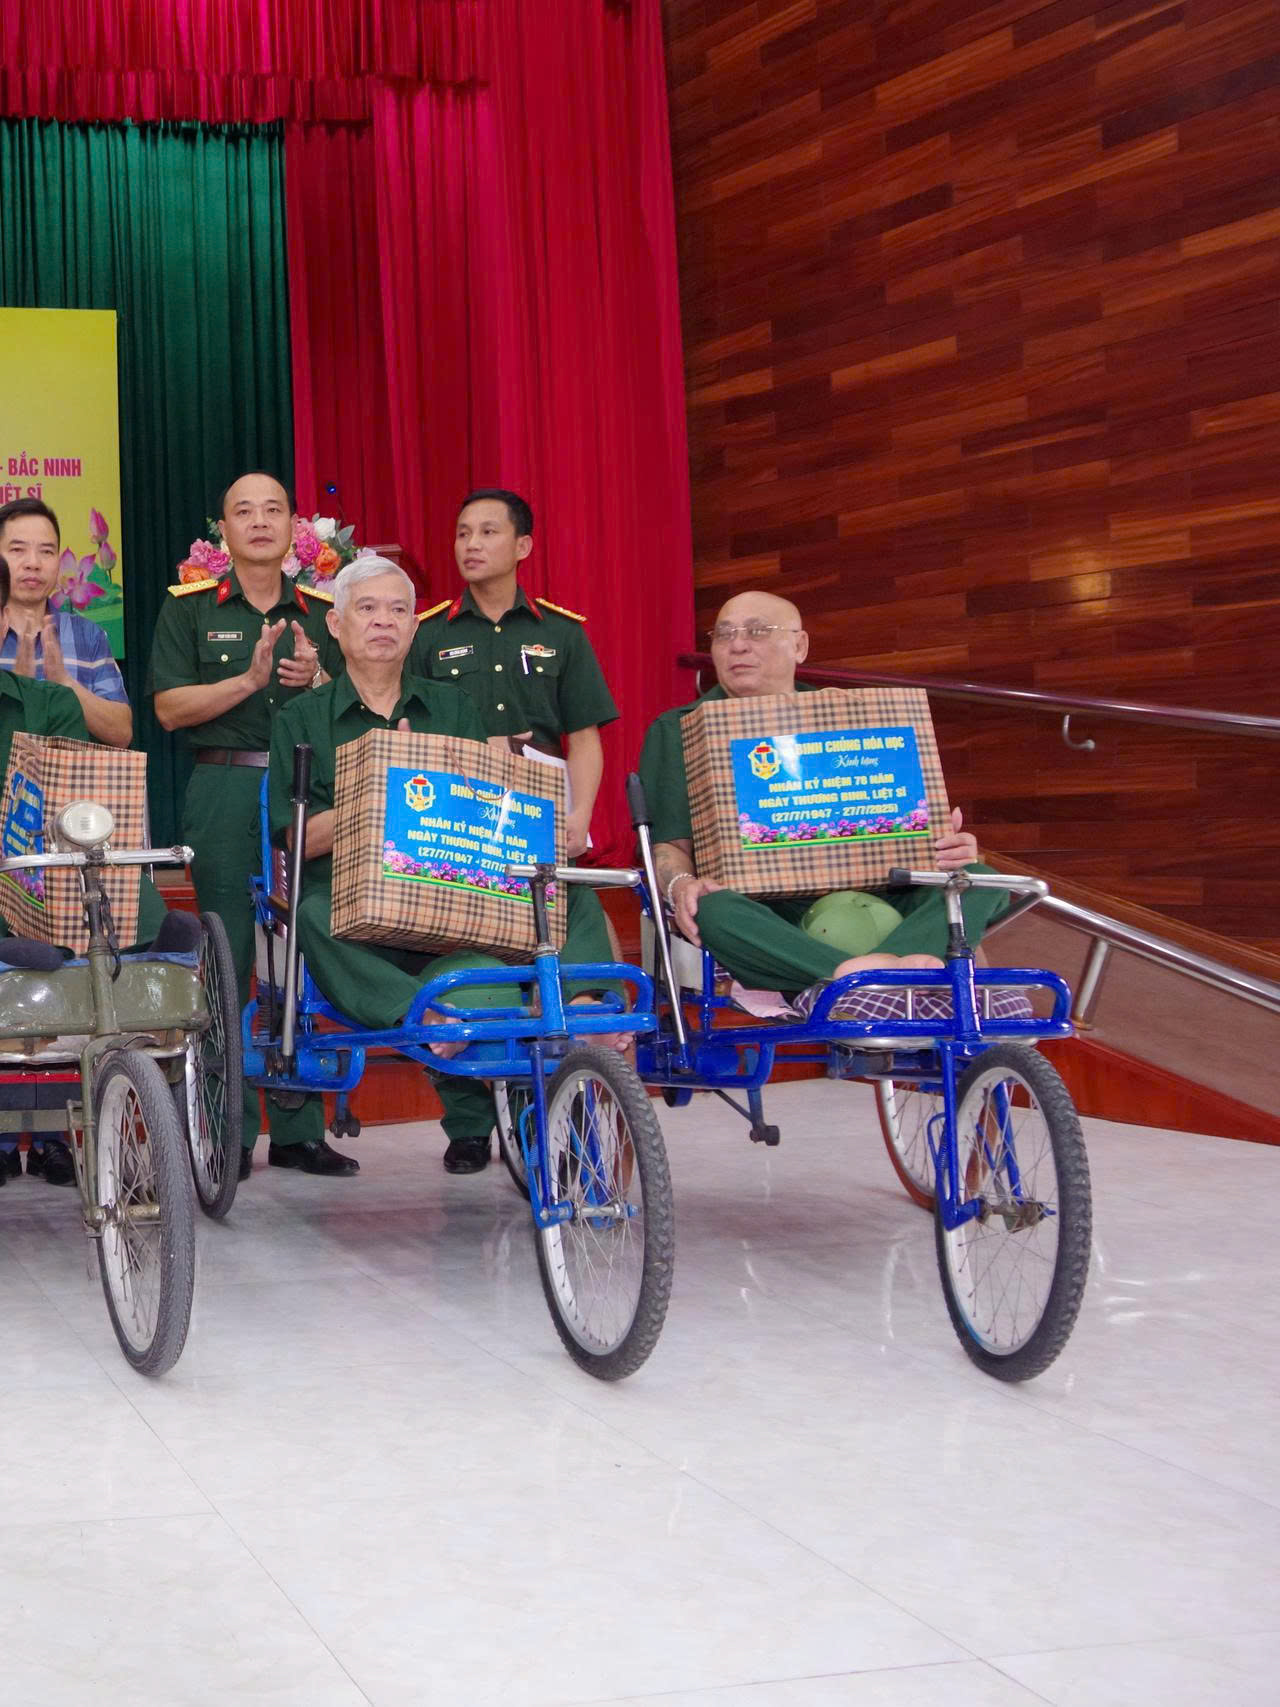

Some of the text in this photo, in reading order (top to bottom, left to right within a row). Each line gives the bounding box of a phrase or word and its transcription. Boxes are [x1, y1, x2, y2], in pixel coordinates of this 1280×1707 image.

[8, 451, 39, 476] BẮC
[44, 458, 81, 476] NINH
[407, 830, 438, 842] NGÀY
